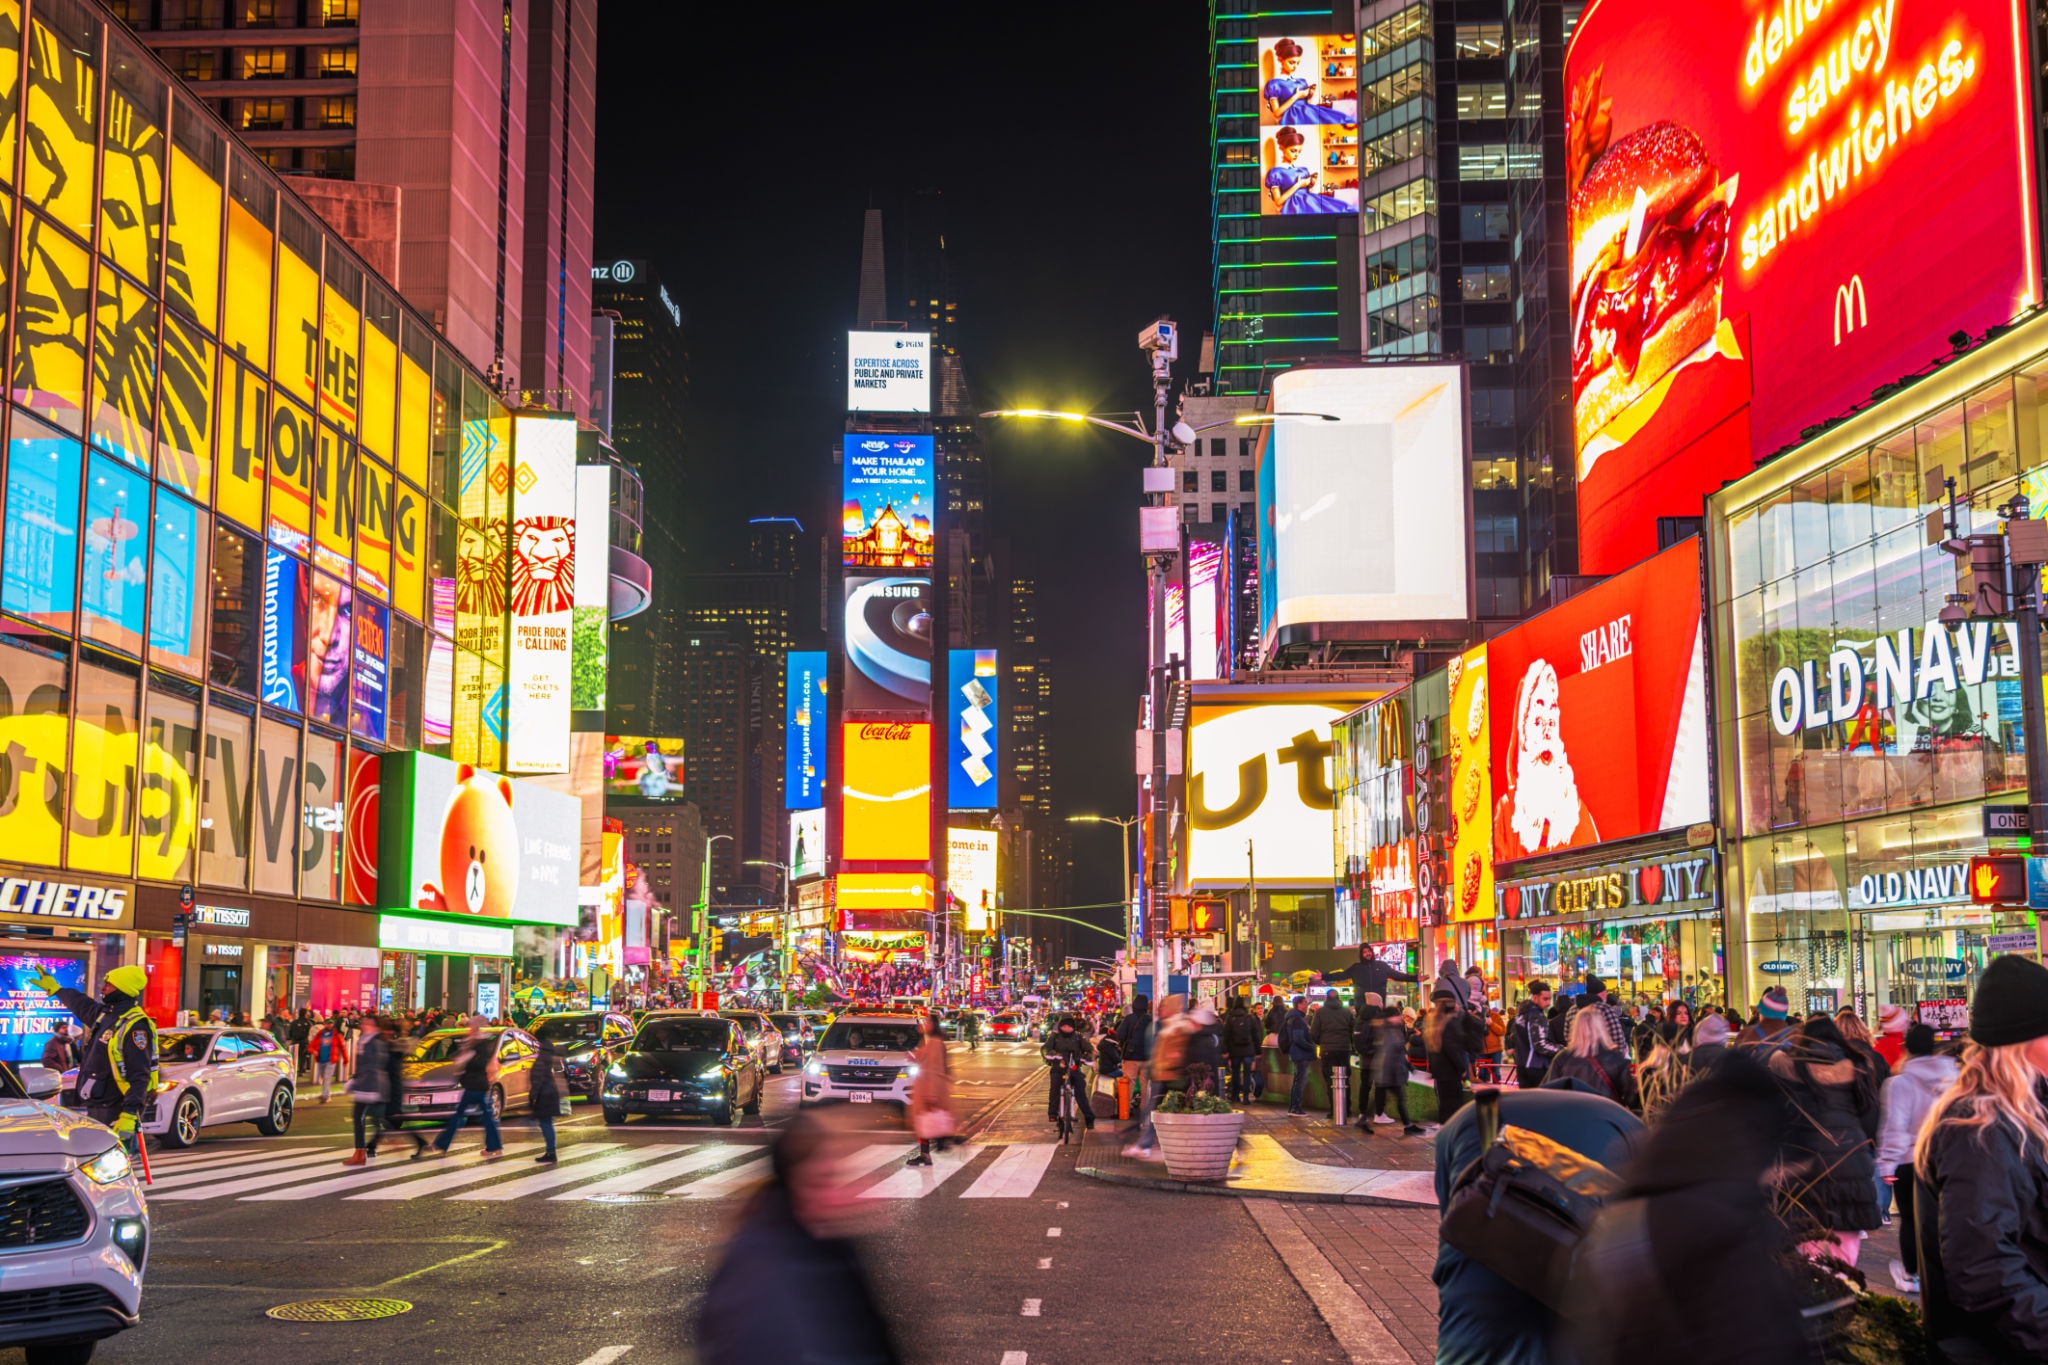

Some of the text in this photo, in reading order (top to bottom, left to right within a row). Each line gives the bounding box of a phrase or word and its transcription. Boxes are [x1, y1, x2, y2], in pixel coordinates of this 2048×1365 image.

[1788, 0, 1895, 134] saucy
[1742, 40, 1974, 270] sandwiches.
[302, 317, 357, 408] THE
[854, 358, 919, 368] EXPERTISE ACROSS
[854, 369, 923, 380] PUBLIC AND PRIVATE
[854, 379, 887, 389] MARKETS
[232, 341, 415, 557] LION KING
[852, 457, 925, 467] MAKE THAILAND
[861, 467, 916, 476] YOUR HOME
[857, 586, 920, 597] MSUNG
[518, 626, 566, 638] PRIDE ROCK
[525, 639, 567, 651] CALLING
[1580, 614, 1632, 673] SHARE
[523, 683, 560, 691] TICKETS
[1771, 649, 1865, 736] OLD
[860, 722, 912, 741] Coca-Cola
[1998, 814, 2026, 828] ONE
[977, 840, 989, 852] in
[1860, 863, 1970, 905] OLD NAVY
[0, 877, 128, 921] CHERS
[1555, 872, 1622, 914] GIFTS
[215, 909, 249, 925] TISSOT
[218, 945, 243, 956] TISSOT
[1908, 963, 1961, 973] OLD NAVY
[1919, 998, 1966, 1008] CHICAGO
